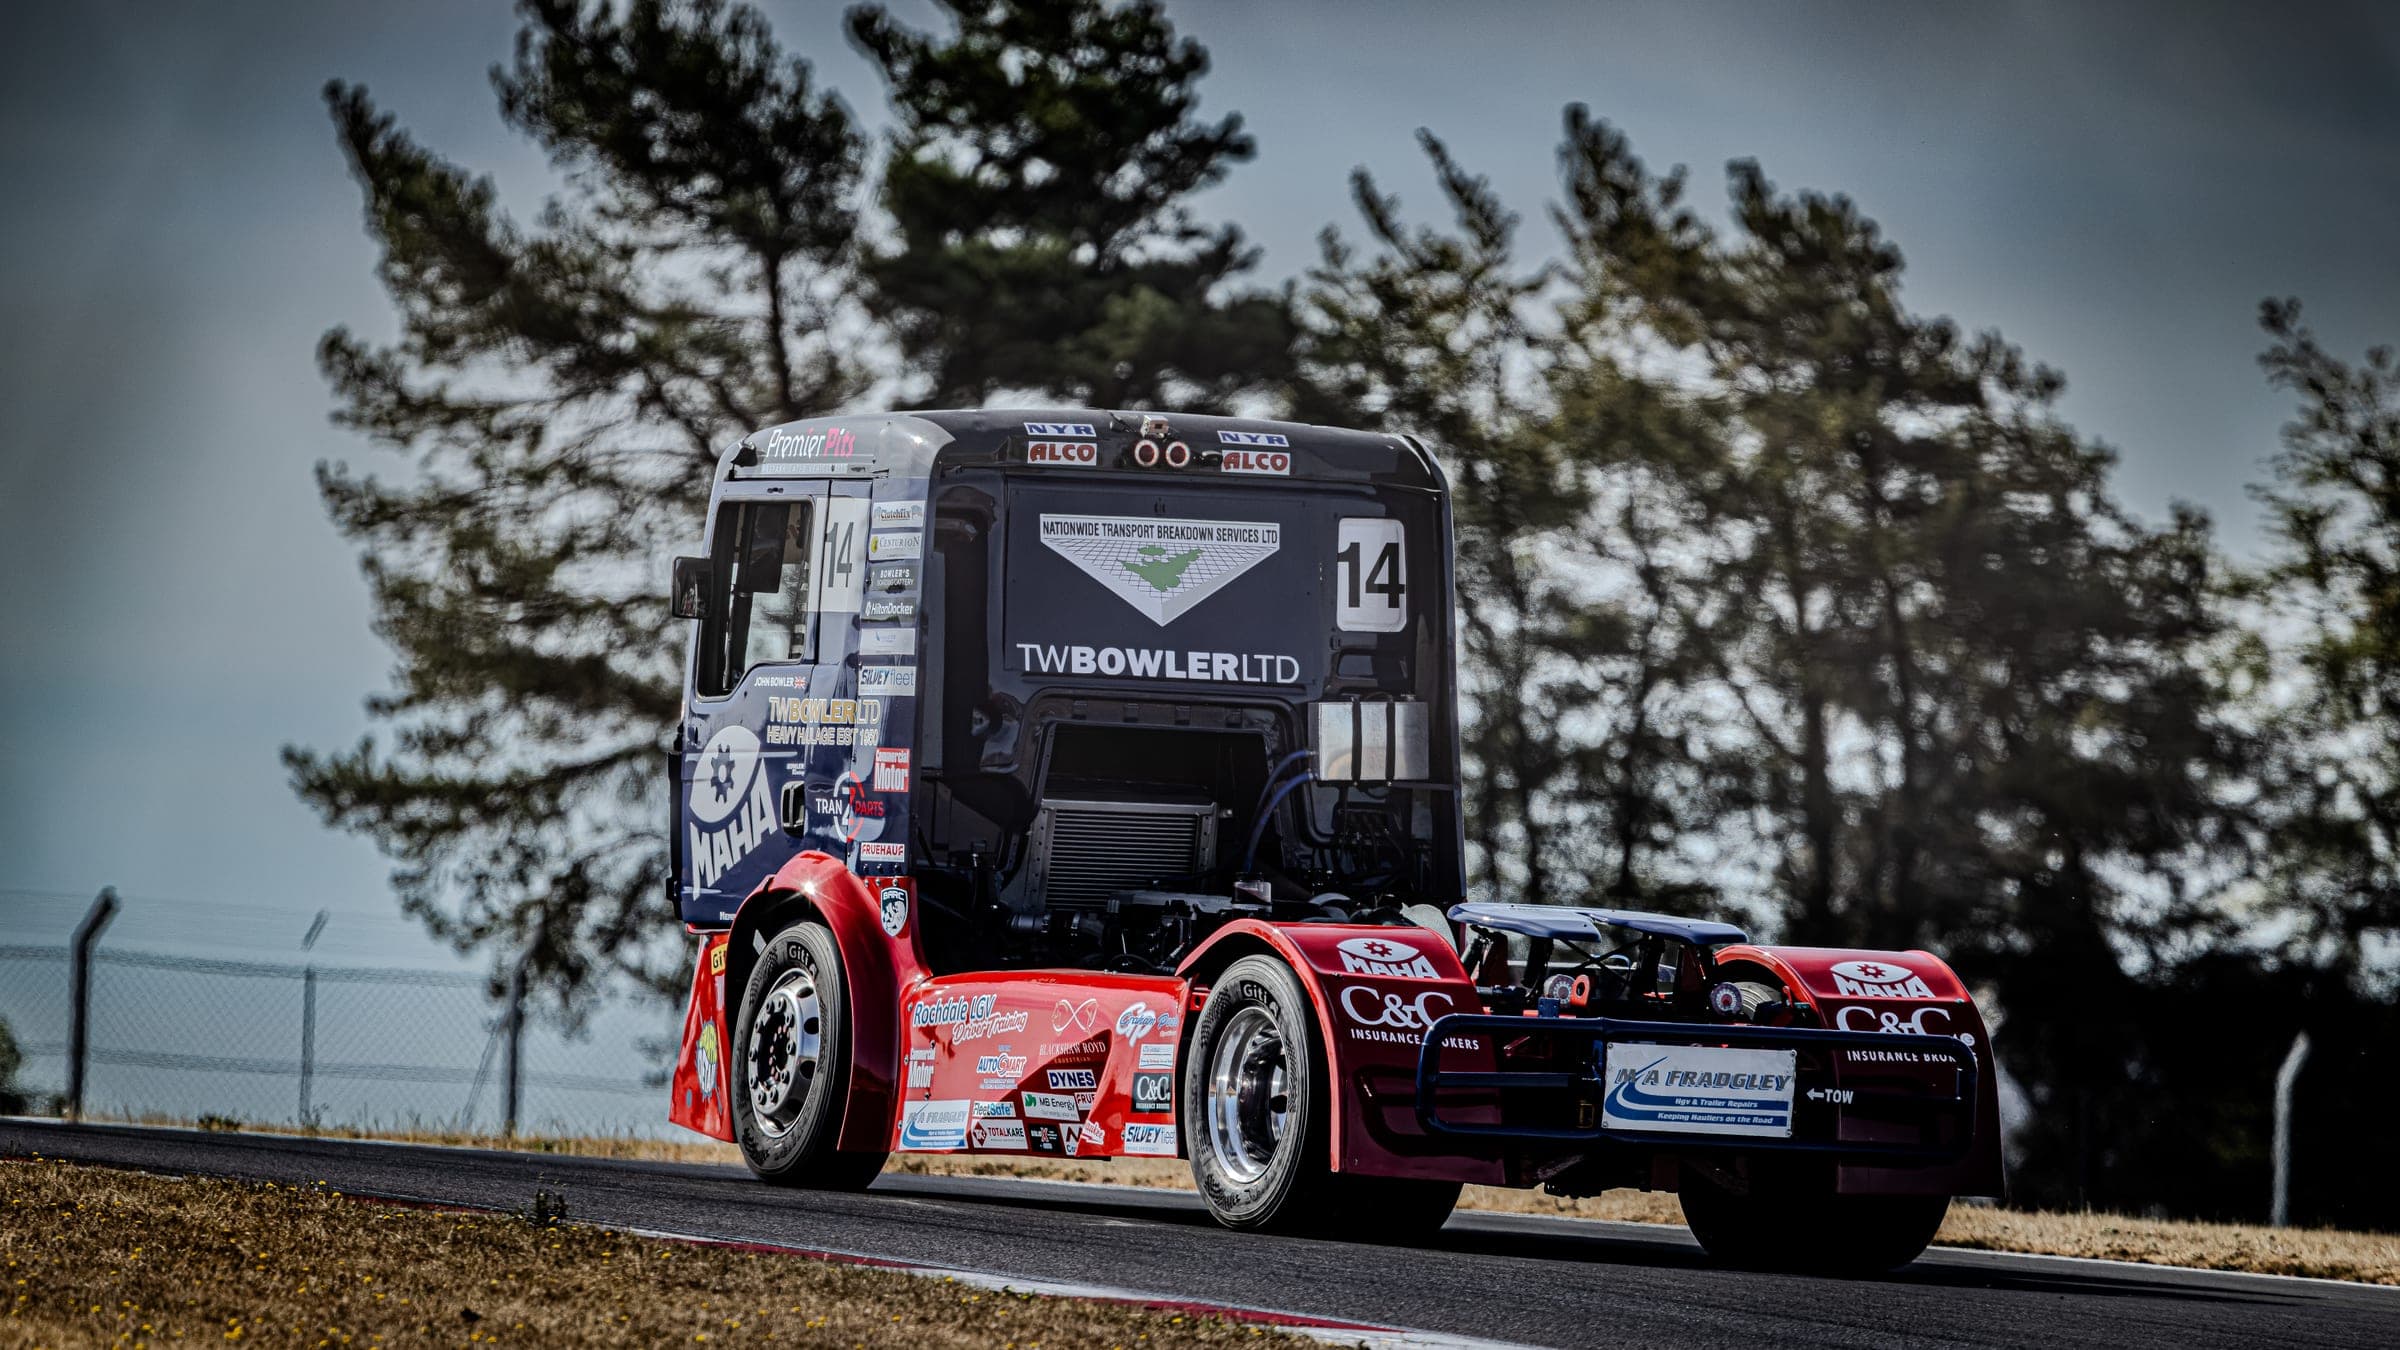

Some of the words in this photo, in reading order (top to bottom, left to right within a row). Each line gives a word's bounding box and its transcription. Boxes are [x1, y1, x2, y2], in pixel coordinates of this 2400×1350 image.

[1026, 424, 1095, 435] NYR
[1220, 432, 1287, 445] NYR
[1029, 443, 1095, 462] ALCO
[1223, 452, 1288, 471] ALCO
[1042, 521, 1100, 537] NATIONWIDE
[1102, 523, 1155, 539] TRANSPORT
[1157, 525, 1214, 542] BREAKDOWN
[1216, 528, 1259, 543] SERVICES
[1262, 529, 1278, 544] LTD
[880, 536, 920, 548] CENTURION
[826, 521, 855, 588] 14
[880, 569, 910, 579] BOWLER'S
[1337, 541, 1405, 609] 14
[754, 676, 769, 687] JOHN
[770, 676, 795, 687] BOWLER
[766, 724, 796, 744] HEAVY
[836, 727, 858, 746] EST
[875, 762, 908, 791] Motor
[689, 757, 778, 902] MAHA
[862, 844, 904, 856] FRUEHAUF
[788, 944, 810, 969] Giti
[1339, 950, 1441, 980] MAHA
[1243, 983, 1268, 1005] Giti
[1832, 972, 1937, 999] MAHA
[912, 996, 968, 1027] Rochdale
[970, 994, 997, 1021] LGV
[1350, 1028, 1421, 1045] INSURANCE
[1082, 1041, 1106, 1054] ROYD
[1848, 1050, 1919, 1062] INSURANCE
[908, 1060, 935, 1088] Motor
[1049, 1072, 1095, 1087] DYNES
[1644, 1069, 1660, 1086] A
[1665, 1070, 1792, 1092] FRADGLEY
[1039, 1096, 1051, 1107] MB
[1052, 1098, 1075, 1111] Energy
[1727, 1100, 1759, 1109] Repairs
[1824, 1088, 1854, 1105] TOW
[1658, 1112, 1689, 1122] Keeping
[1690, 1114, 1724, 1123] Hauliers
[1737, 1116, 1751, 1124] the
[1752, 1117, 1774, 1125] Road
[988, 1127, 1025, 1138] TOTALKARE
